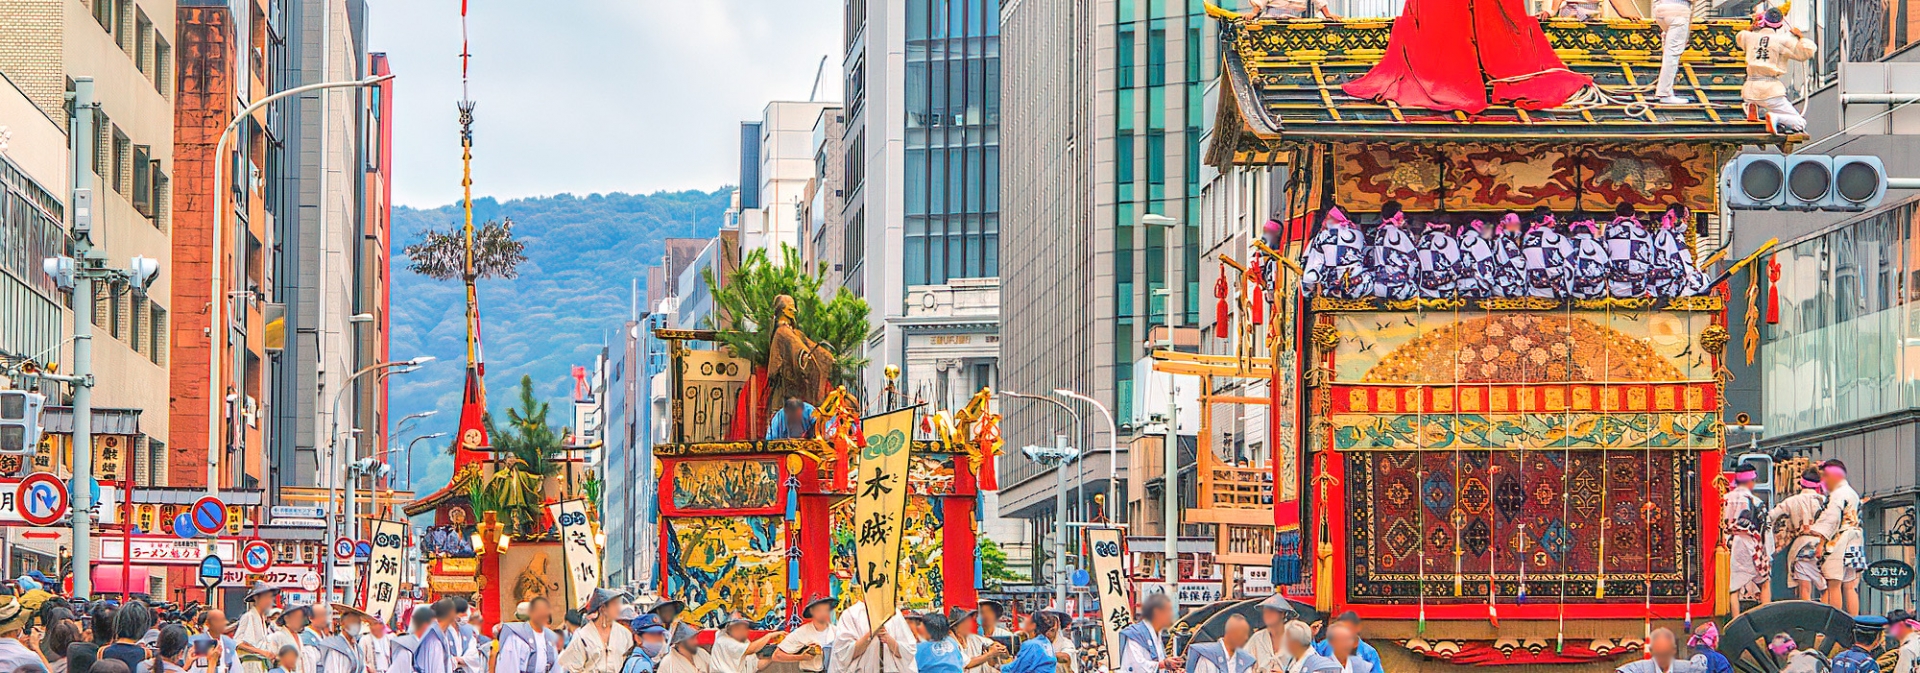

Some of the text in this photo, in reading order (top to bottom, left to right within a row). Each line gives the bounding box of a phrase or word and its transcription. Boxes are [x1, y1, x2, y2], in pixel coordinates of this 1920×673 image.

[1755, 36, 1770, 62] 月鉾
[0, 492, 14, 512] 月
[859, 467, 893, 593] 木賊山
[1870, 566, 1908, 576] 処方せん
[1879, 576, 1898, 587] 受付
[1106, 569, 1131, 632] 月鉾
